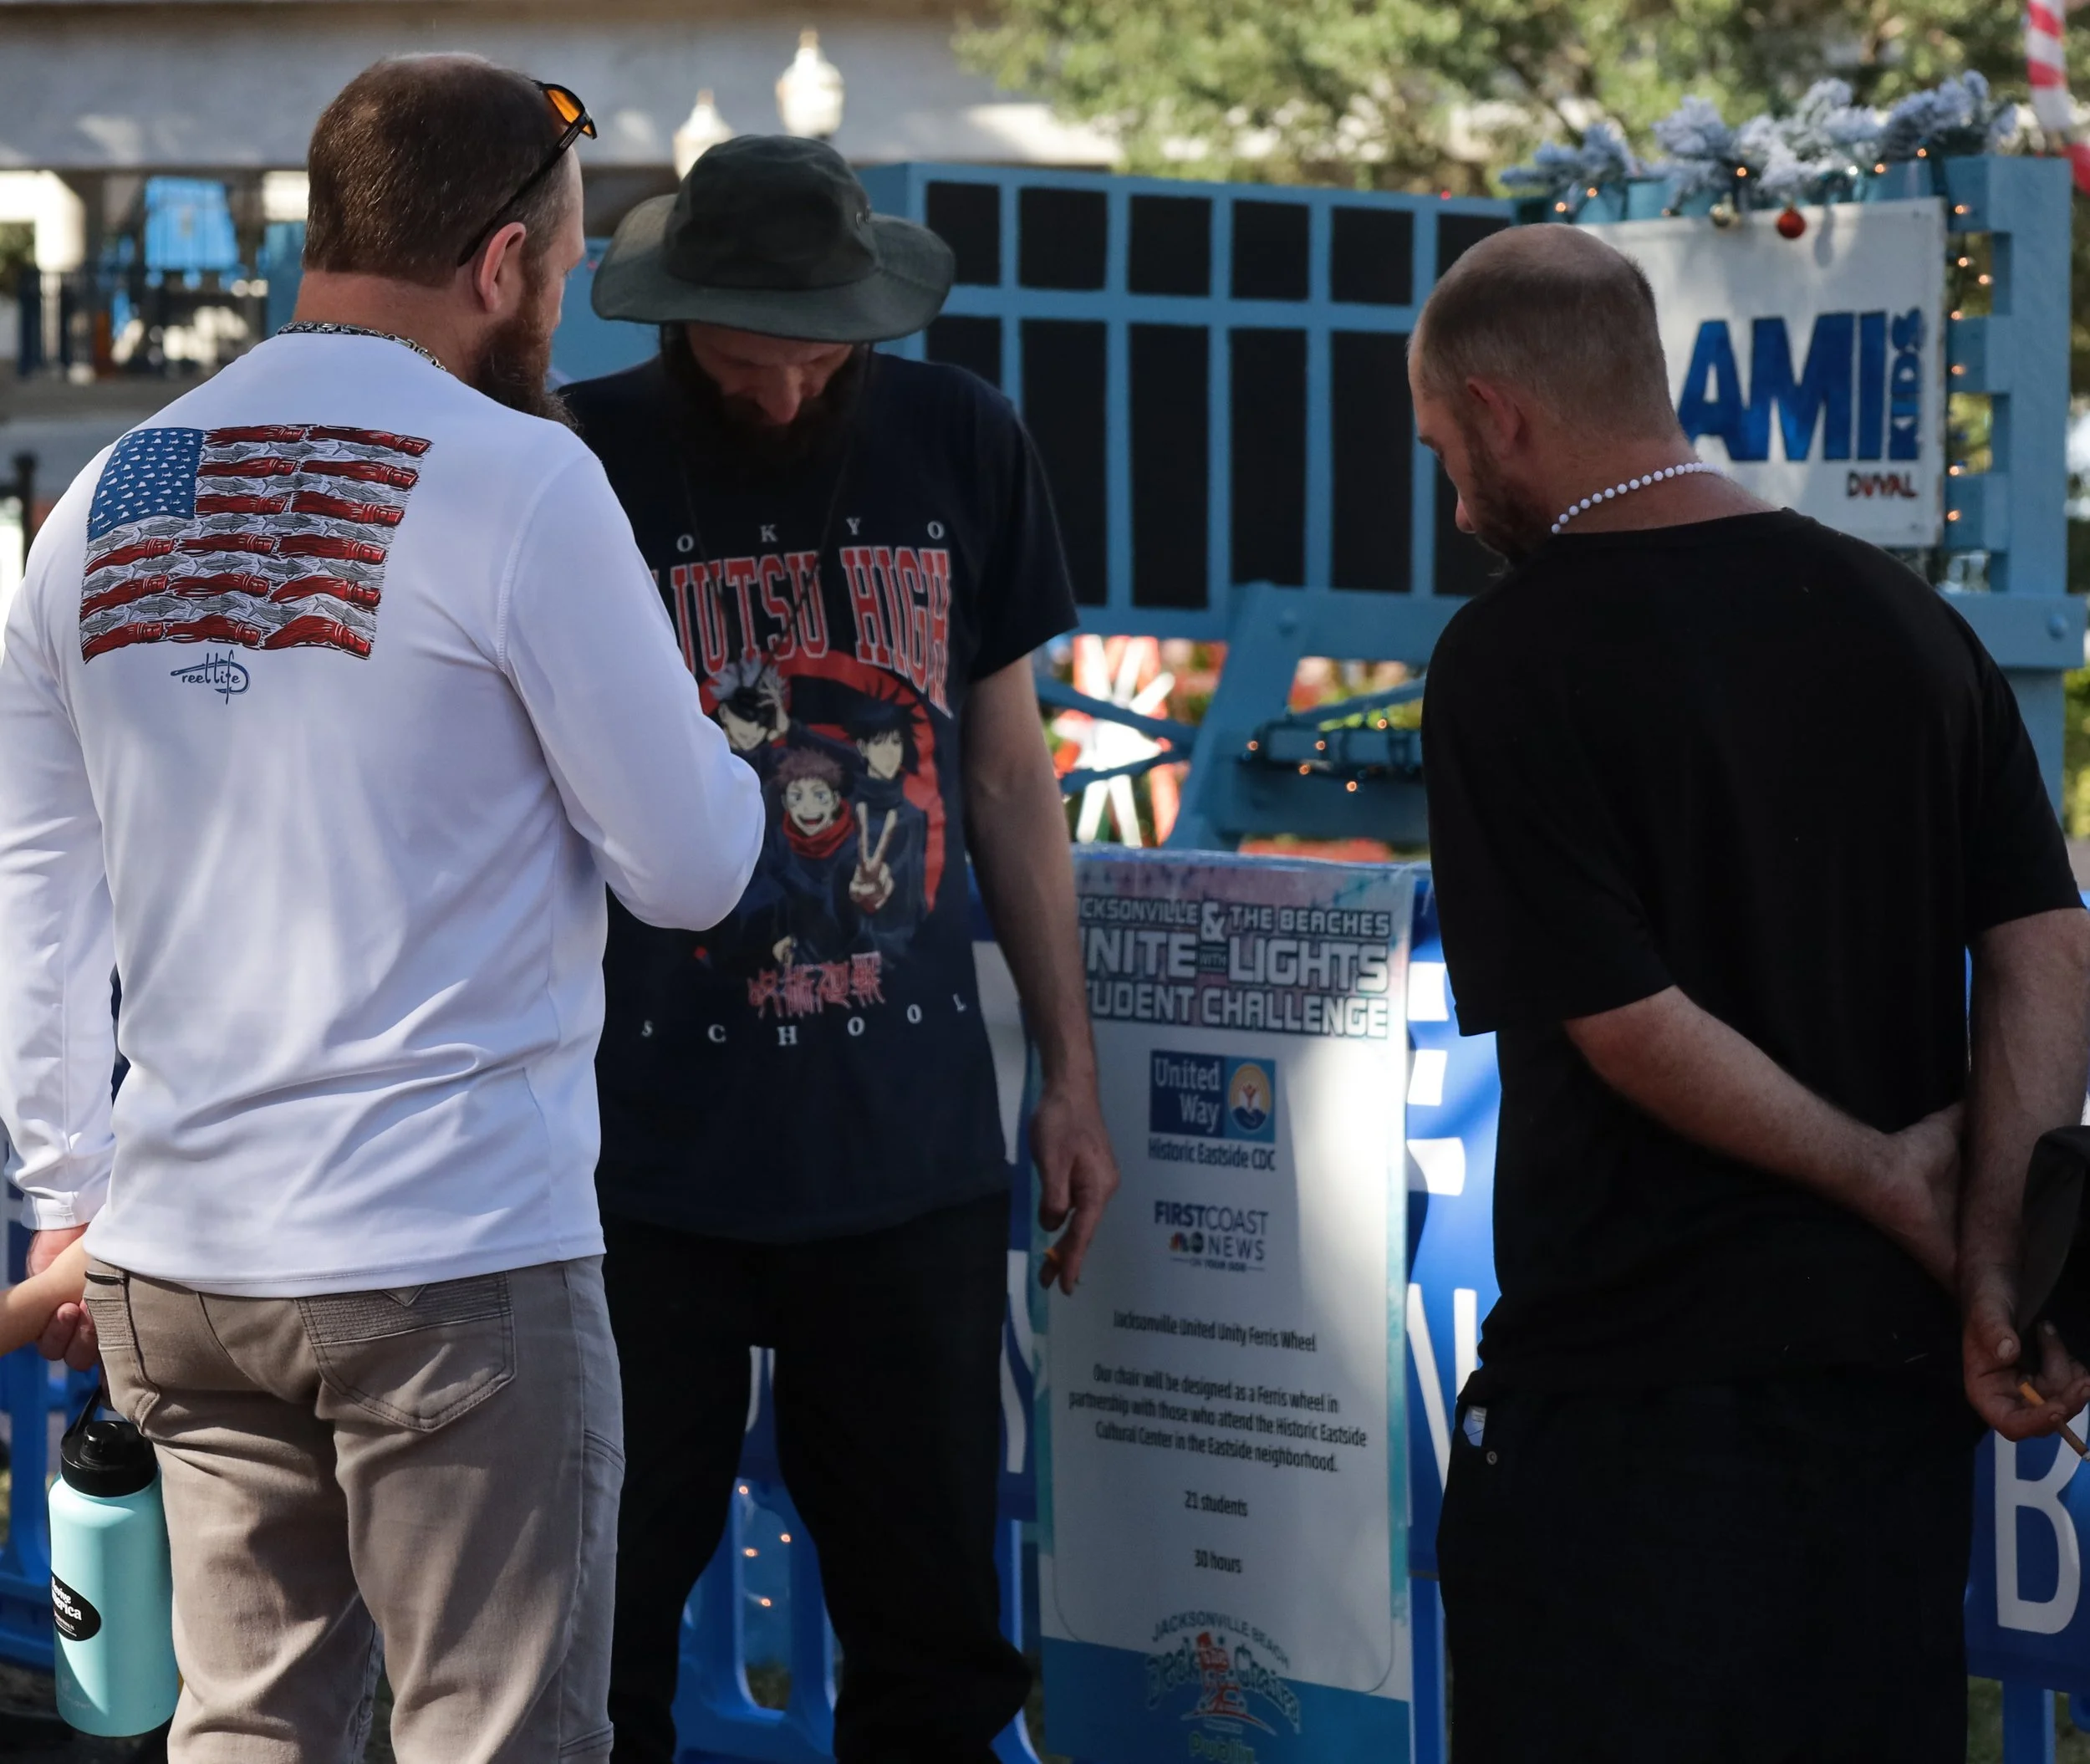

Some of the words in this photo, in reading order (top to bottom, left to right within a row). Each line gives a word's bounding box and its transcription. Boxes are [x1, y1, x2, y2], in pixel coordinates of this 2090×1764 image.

[1677, 310, 1887, 461] AMI
[1847, 470, 1918, 499] DUVAL
[676, 517, 946, 553] OKYO
[652, 549, 830, 679] JUTSU
[839, 545, 953, 719] HIGH
[1078, 896, 1198, 925] CKSONVILLE
[1200, 901, 1226, 942] &
[1230, 906, 1272, 930] THE
[1280, 910, 1389, 936] BEACHES
[1229, 936, 1389, 994] LIGHTS
[640, 994, 966, 1047] SCHOOL
[1087, 979, 1195, 1022] UDENT
[1201, 987, 1389, 1040] CHALLENGE
[1154, 1058, 1221, 1091] United
[1180, 1092, 1221, 1134] Way
[1148, 1137, 1195, 1163] Historic
[1197, 1142, 1249, 1168] Eastside
[1252, 1149, 1276, 1171] CDC
[1208, 1234, 1265, 1261] NEWS
[1114, 1310, 1177, 1334] Jacksonville
[1180, 1318, 1215, 1339] United
[1218, 1323, 1246, 1346] Unity
[1249, 1325, 1278, 1348] Ferris
[1281, 1330, 1318, 1352] Wheel
[1093, 1364, 1112, 1382] Our
[1114, 1366, 1139, 1387] chair
[1143, 1370, 1163, 1389] will
[1166, 1374, 1179, 1391] be
[1181, 1375, 1231, 1400] designed
[1235, 1384, 1246, 1401] as
[1249, 1388, 1255, 1402] a
[1257, 1385, 1287, 1407] Ferris
[1290, 1390, 1324, 1412] wheel
[1328, 1394, 1339, 1413] in
[1068, 1391, 1129, 1416] partnership
[1132, 1397, 1155, 1418] with
[1159, 1401, 1188, 1421] those
[1190, 1406, 1215, 1425] who
[1218, 1410, 1252, 1431] attend
[1255, 1414, 1272, 1434] the
[1276, 1417, 1318, 1440] Historic
[1320, 1424, 1368, 1447] Eastside
[1095, 1420, 1136, 1444] Cultural
[1139, 1427, 1173, 1448] Center
[1175, 1432, 1185, 1450] in
[1188, 1433, 1206, 1453] the
[1208, 1436, 1252, 1461] Eastside
[1255, 1445, 1339, 1471] neighborhood.
[1185, 1490, 1198, 1510] 21
[1201, 1494, 1248, 1517] students
[1210, 1551, 1243, 1573] hours
[52, 1588, 82, 1621] erica
[1152, 1610, 1249, 1643] JACKSONVILLE
